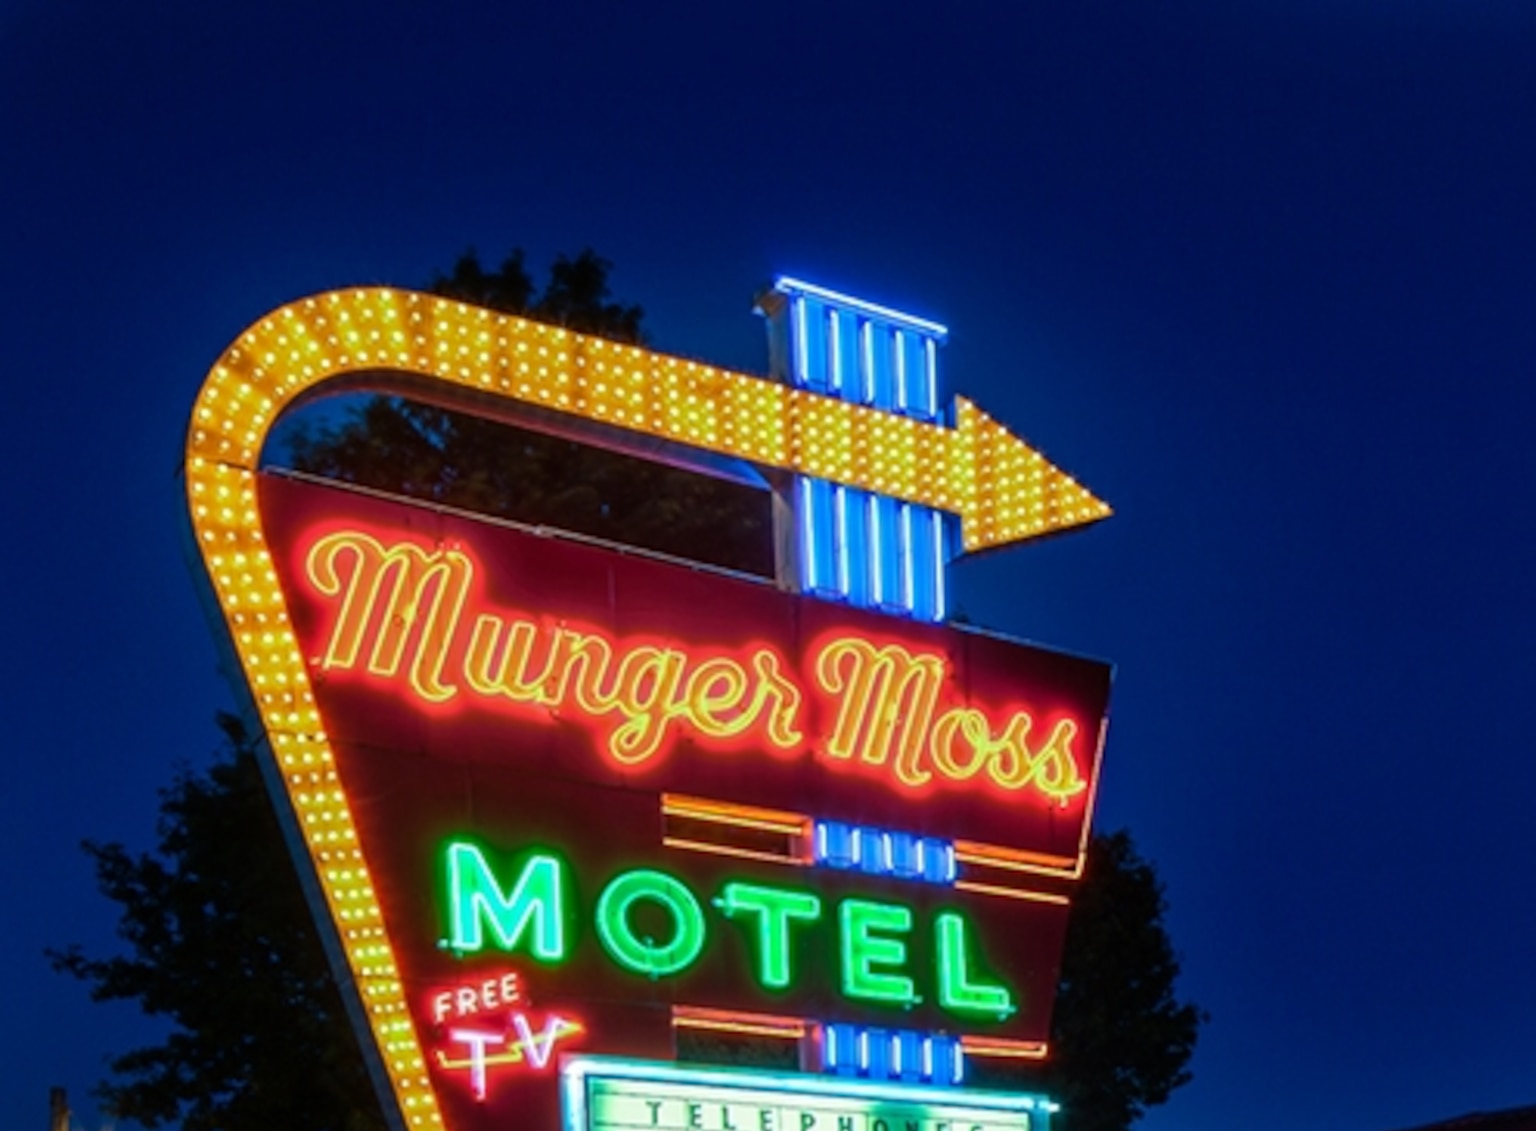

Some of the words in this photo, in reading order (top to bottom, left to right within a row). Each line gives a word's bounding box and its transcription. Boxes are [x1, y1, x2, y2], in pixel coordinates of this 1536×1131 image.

[306, 530, 801, 765] Munger
[816, 637, 1086, 798] Moss
[446, 842, 1012, 1012] MOTEL
[434, 972, 520, 1023] FREE
[450, 1011, 568, 1101] TV
